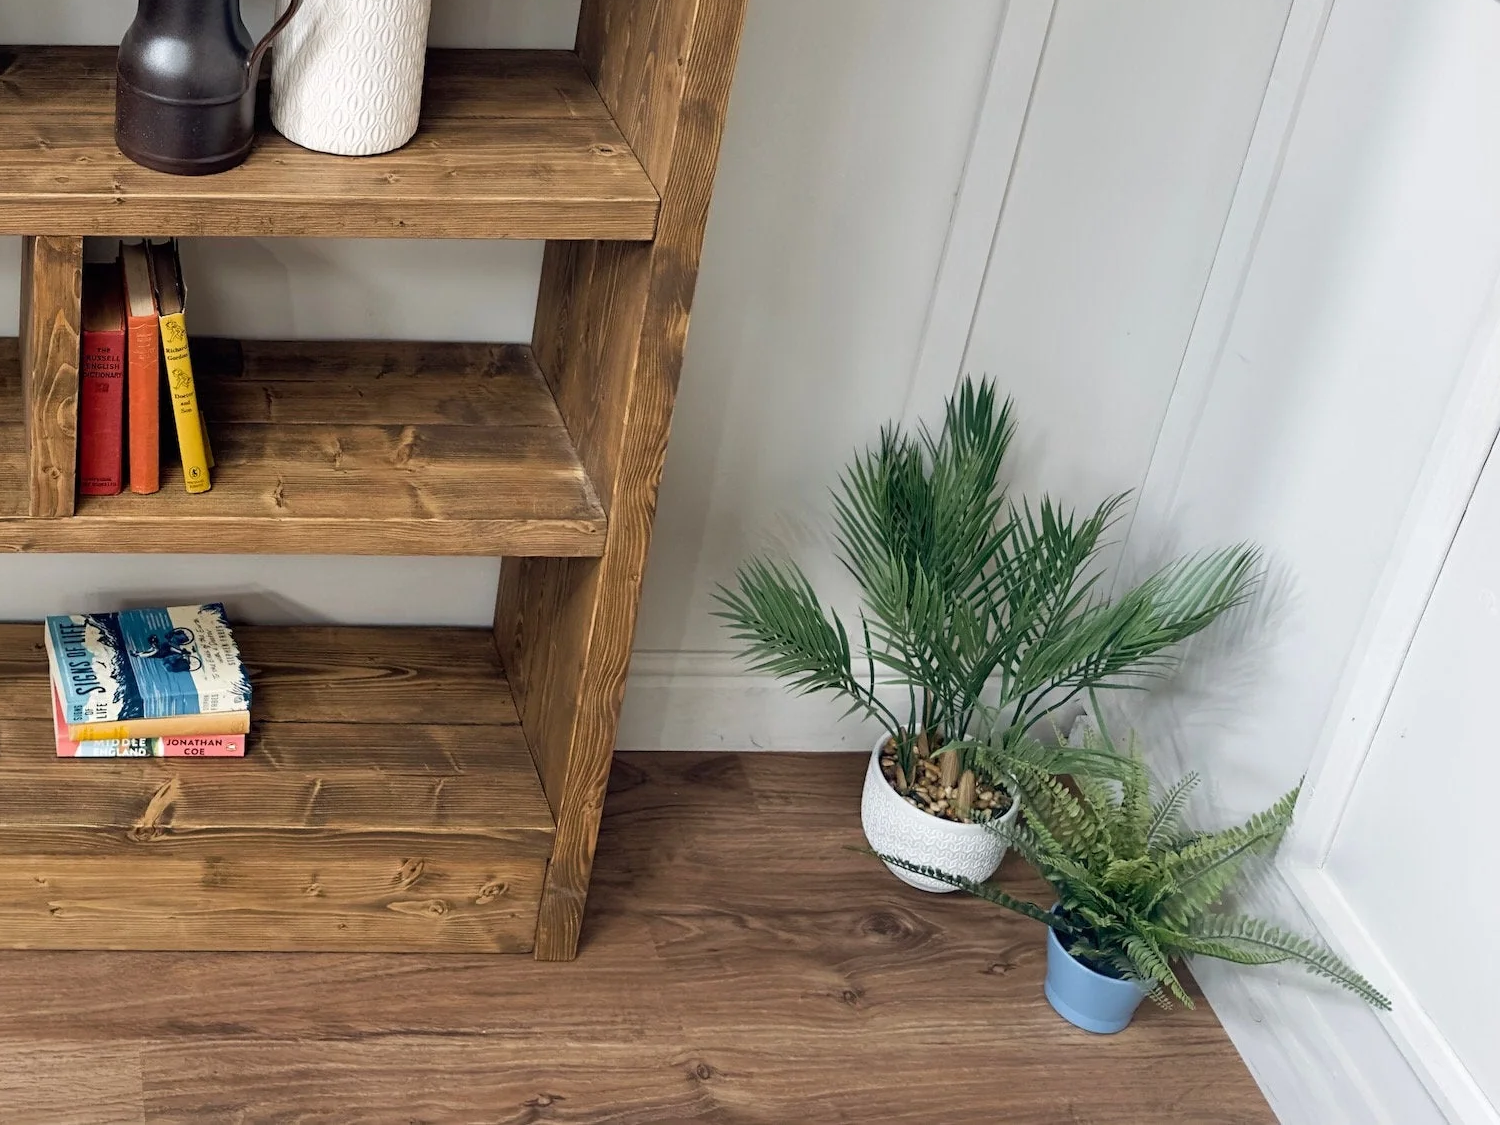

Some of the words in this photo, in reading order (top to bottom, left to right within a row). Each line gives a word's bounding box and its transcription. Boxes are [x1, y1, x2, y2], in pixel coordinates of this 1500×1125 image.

[167, 353, 188, 361] Gordon
[59, 623, 86, 643] LIFE
[66, 648, 86, 658] OF
[69, 661, 106, 695] SIGNS
[73, 705, 83, 721] SIGNS
[96, 703, 107, 719] LIFE
[94, 738, 146, 747] MIDDLE
[94, 748, 146, 756] ENGLAND
[184, 748, 205, 756] COE
